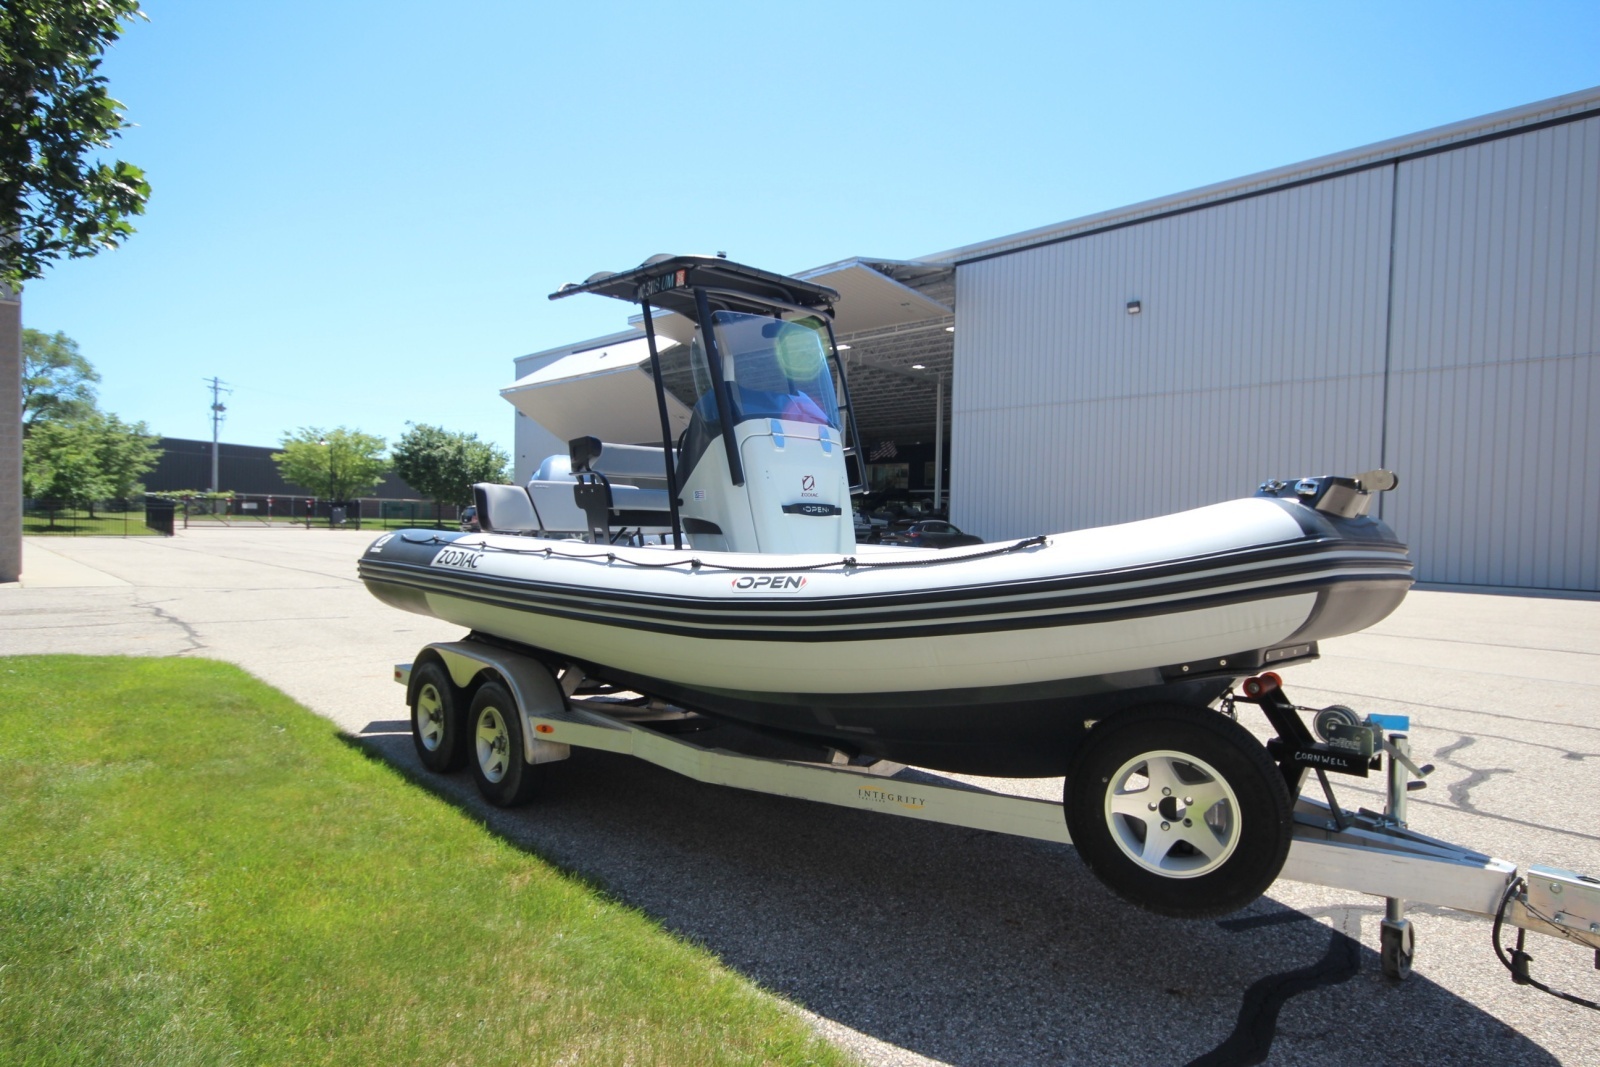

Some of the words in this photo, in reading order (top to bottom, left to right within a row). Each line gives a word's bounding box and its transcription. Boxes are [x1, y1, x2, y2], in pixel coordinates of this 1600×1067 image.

[805, 505, 828, 513] OPEN
[436, 549, 484, 569] ZODIAC
[736, 575, 803, 589] OPEN
[1294, 751, 1348, 767] CORNWELL
[858, 788, 925, 806] INTEGRITY
